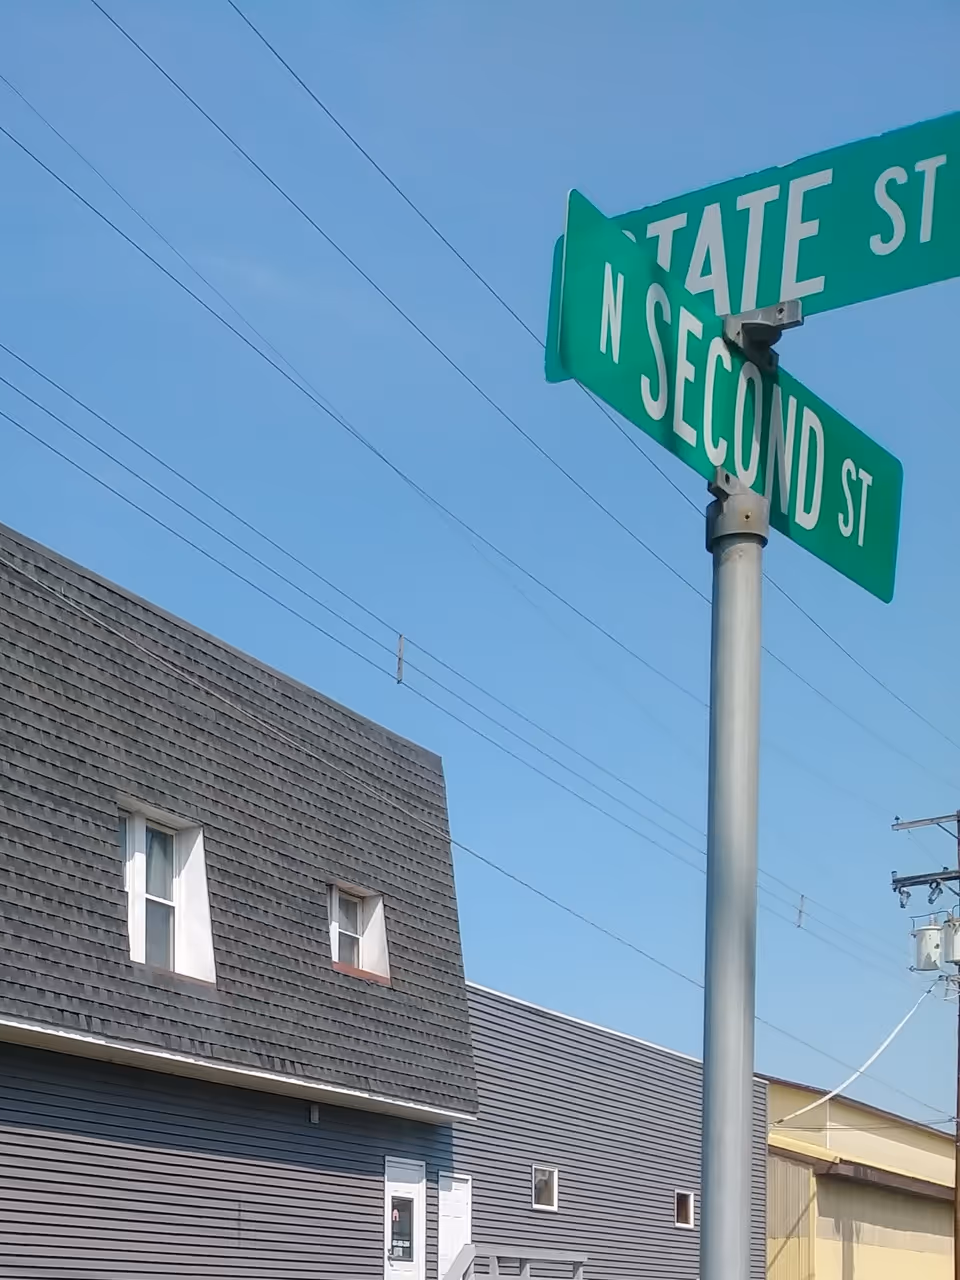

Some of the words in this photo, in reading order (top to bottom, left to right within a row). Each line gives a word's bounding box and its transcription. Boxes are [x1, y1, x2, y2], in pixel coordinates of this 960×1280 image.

[622, 168, 834, 316] TATE
[869, 154, 947, 256] ST
[600, 262, 624, 364] N
[641, 282, 825, 531] SECOND
[838, 458, 874, 547] ST
